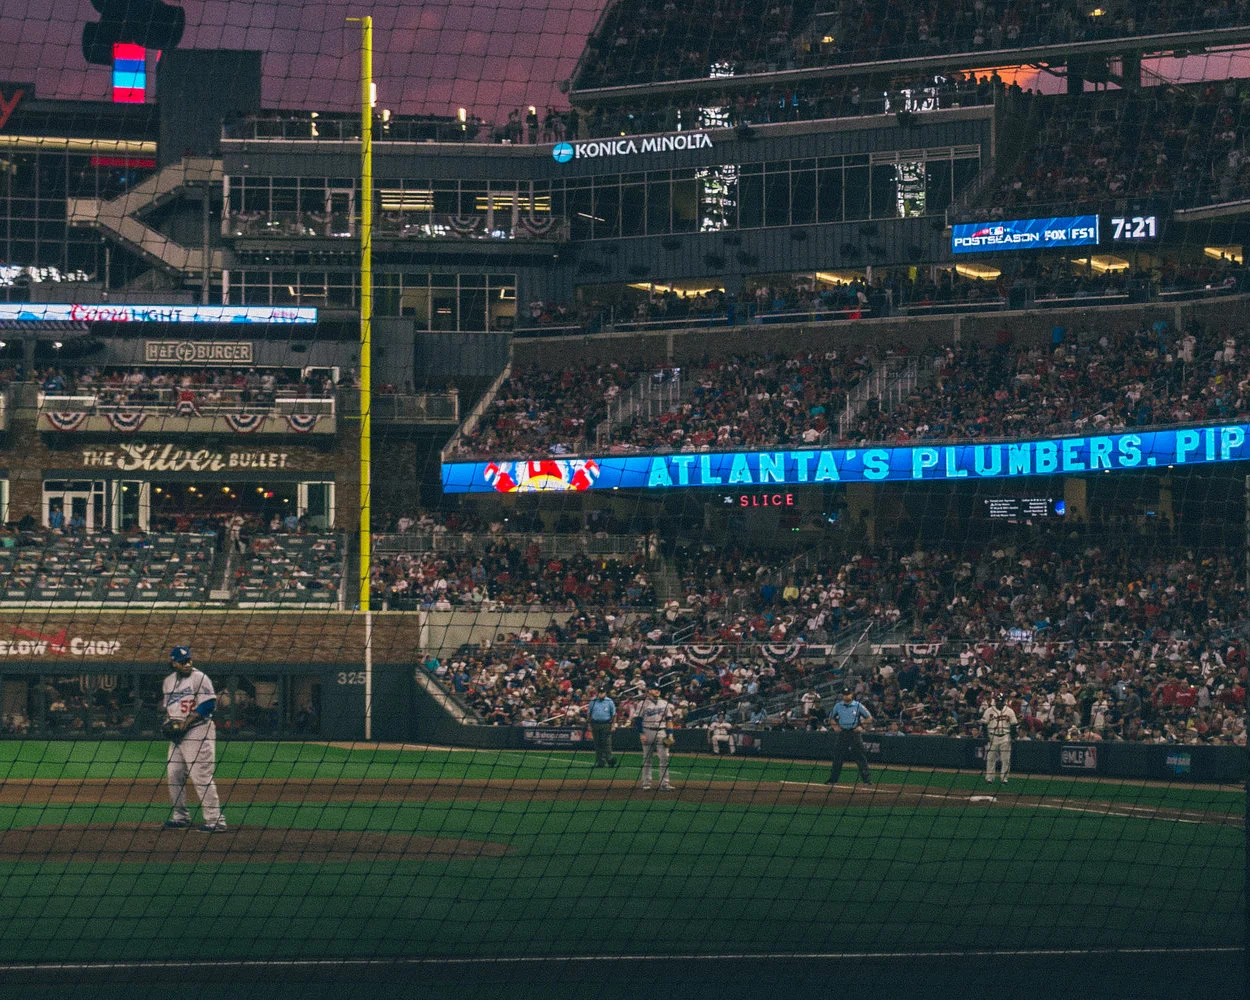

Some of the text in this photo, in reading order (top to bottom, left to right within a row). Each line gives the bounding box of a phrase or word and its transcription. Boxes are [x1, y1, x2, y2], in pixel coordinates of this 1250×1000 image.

[575, 134, 713, 159] KONICA MINOLTA
[1045, 227, 1095, 241] FOX FS1
[1111, 216, 1156, 240] 7:21
[954, 233, 1040, 247] POSTSEASON
[70, 304, 183, 323] Coors LIGHT
[150, 343, 176, 362] H&F
[198, 343, 250, 362] BURGER
[82, 443, 288, 471] THE Silver BULLET
[648, 449, 889, 487] ATLANTA'S
[740, 493, 794, 507] SLICE
[337, 671, 367, 685] 325
[180, 700, 196, 714] 52
